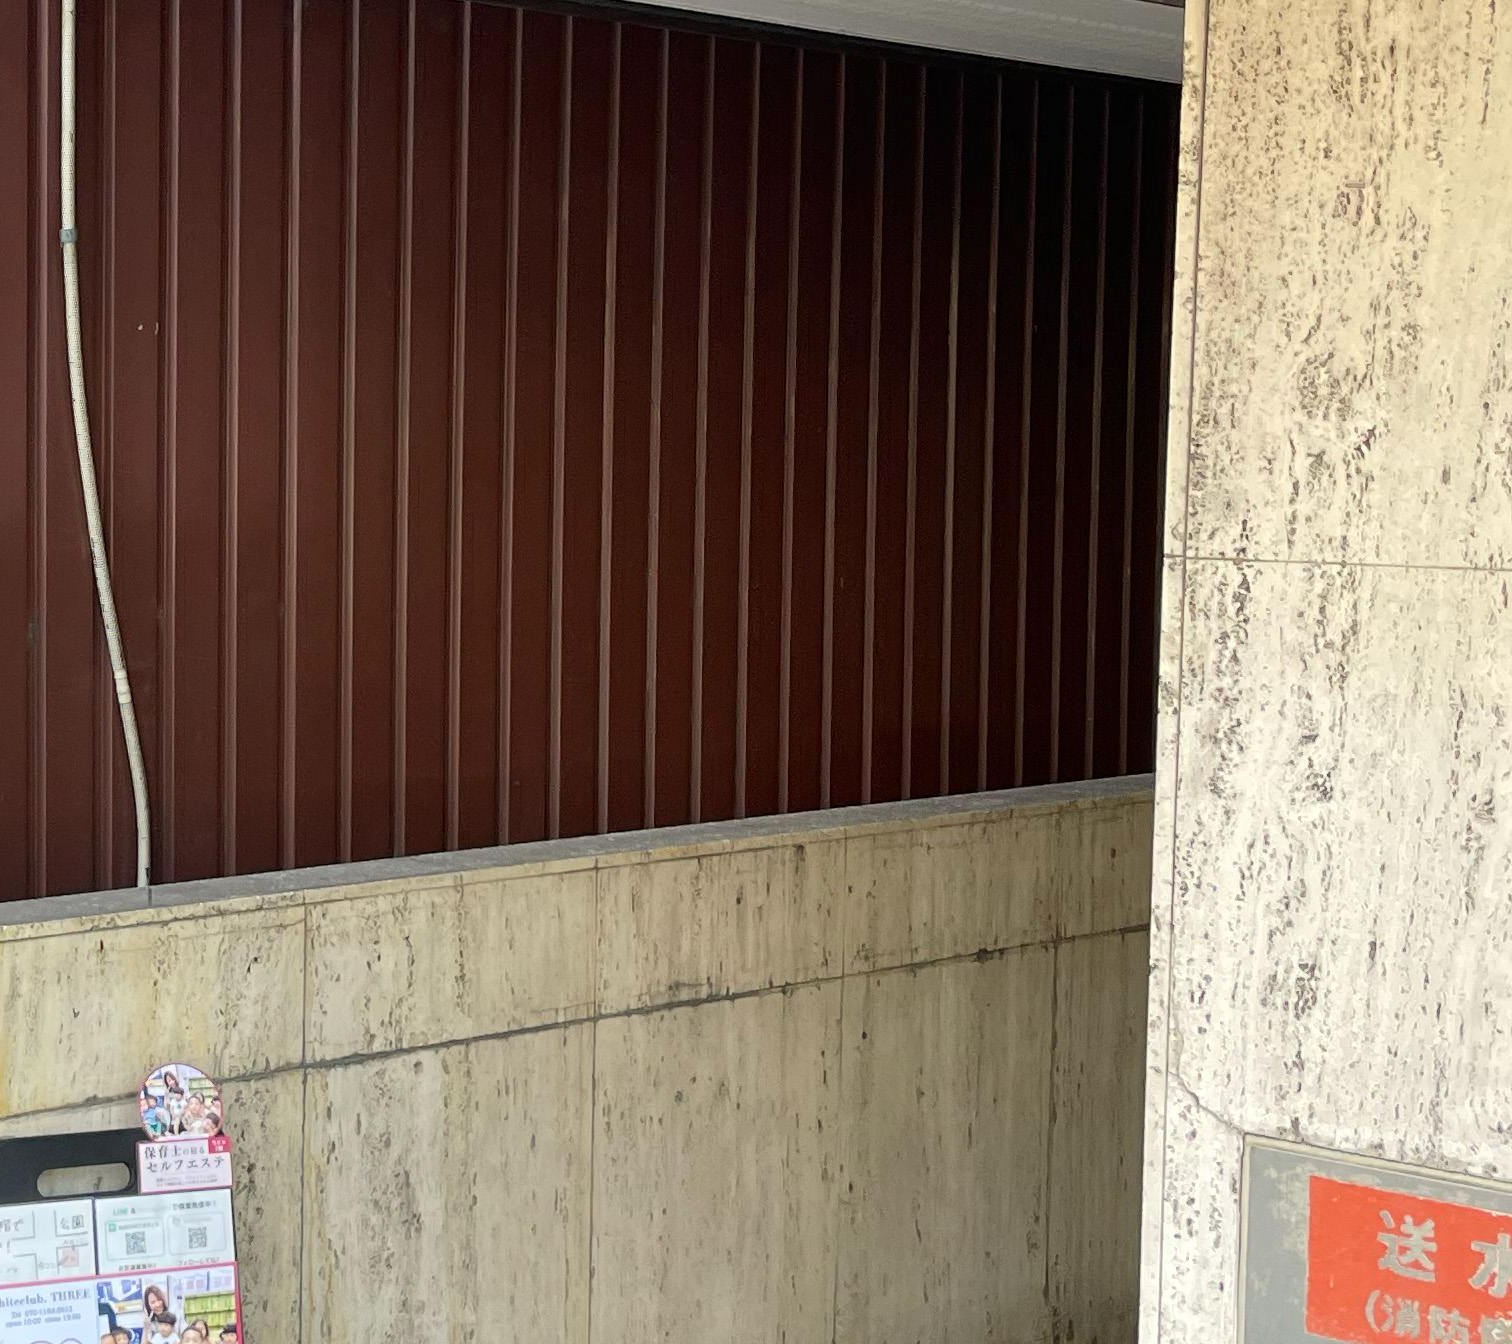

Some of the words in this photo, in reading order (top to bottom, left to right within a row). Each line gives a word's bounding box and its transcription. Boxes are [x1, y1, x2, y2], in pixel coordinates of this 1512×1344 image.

[146, 1156, 225, 1173] セルフエステ
[60, 1214, 85, 1230] 公園
[50, 1288, 92, 1303] THREE
